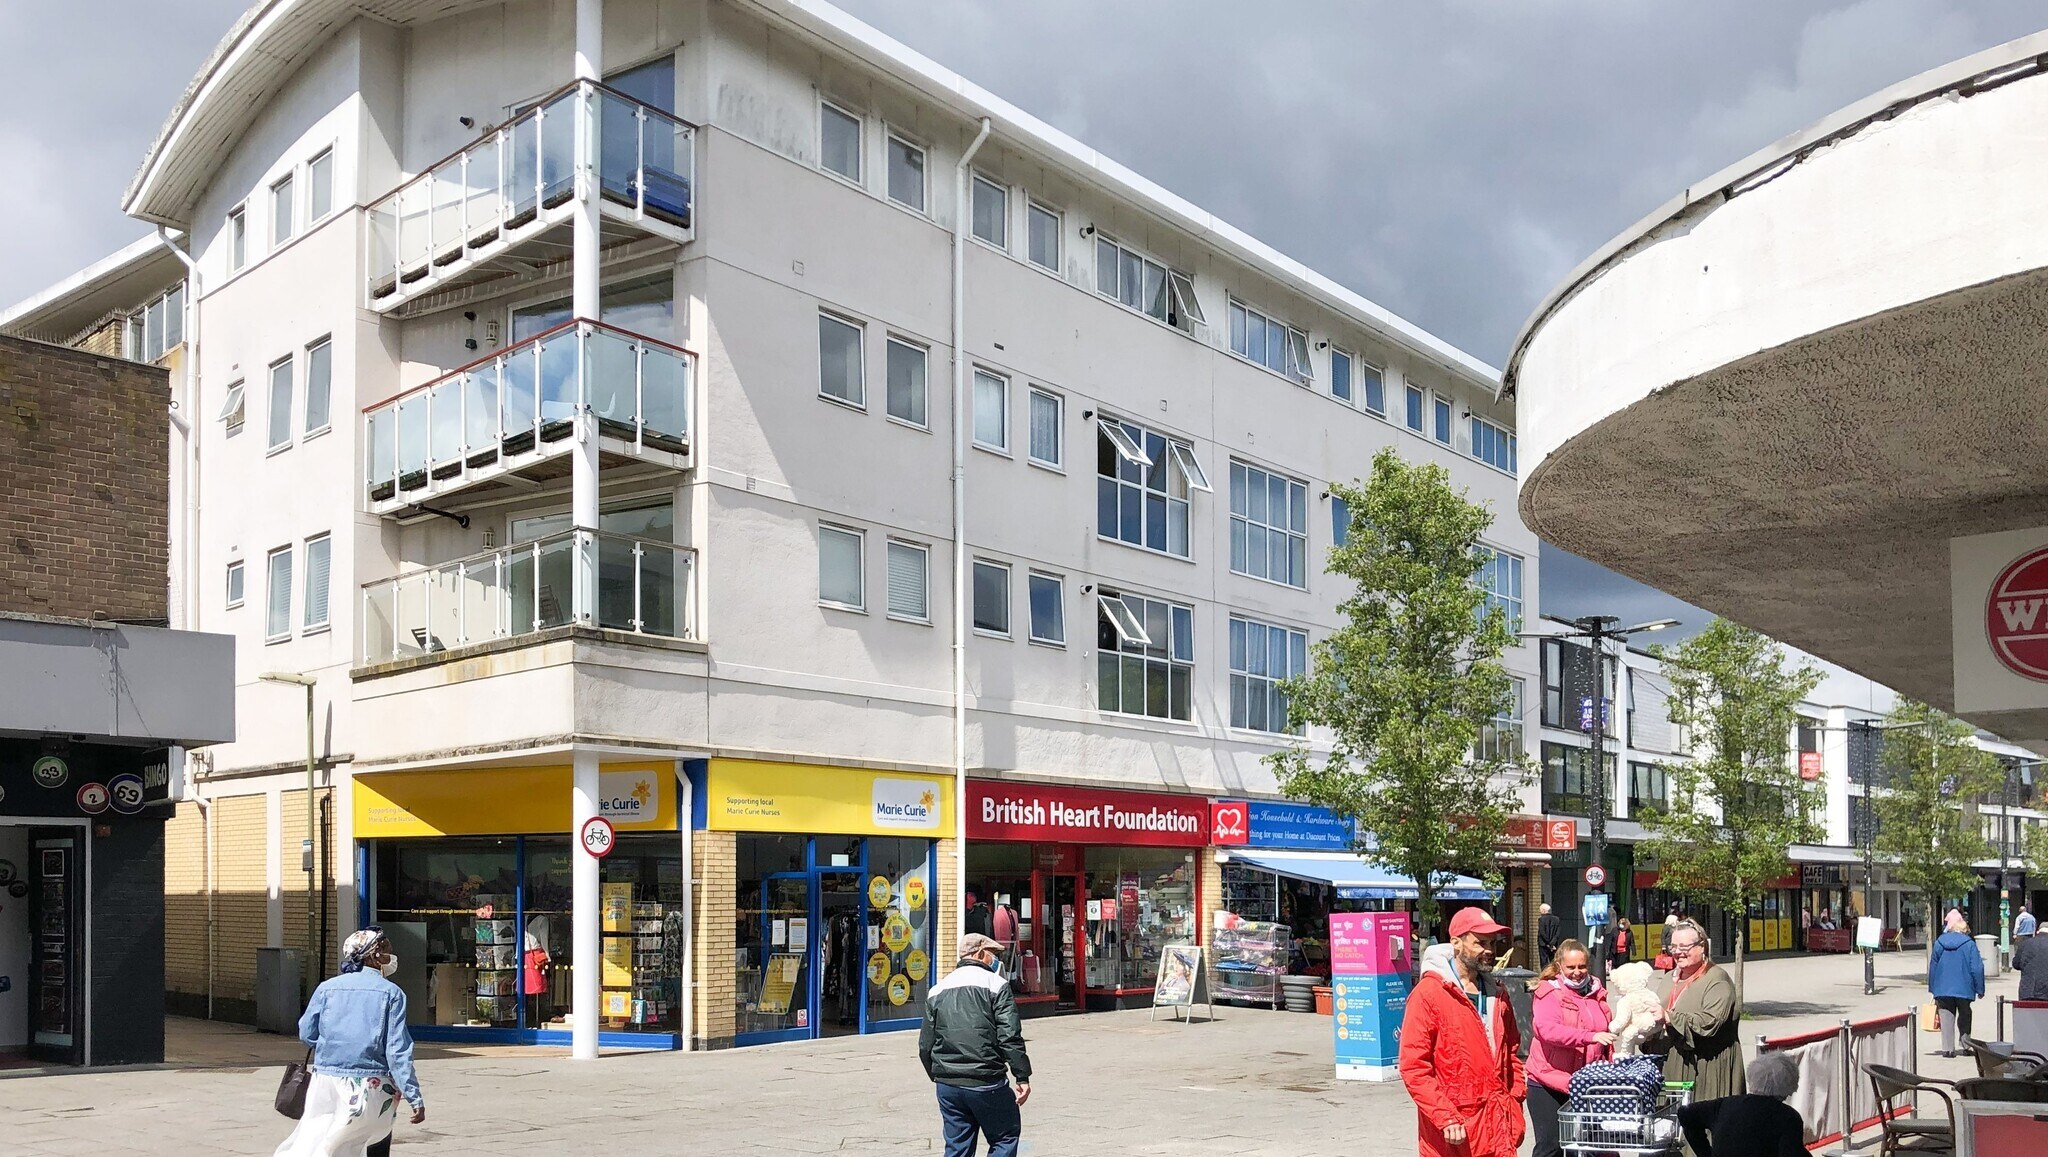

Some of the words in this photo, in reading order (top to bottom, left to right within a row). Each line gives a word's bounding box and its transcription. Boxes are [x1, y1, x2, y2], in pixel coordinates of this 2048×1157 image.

[1997, 599, 2048, 633] W
[41, 766, 60, 780] 33
[144, 762, 167, 790] BINGO
[88, 793, 98, 804] 2
[116, 785, 140, 803] 69
[612, 797, 640, 810] Curie
[726, 796, 759, 807] Supporting
[760, 798, 774, 806] local
[368, 807, 397, 815] Supporting
[726, 807, 744, 815] Marie
[744, 808, 760, 816] Curie
[760, 808, 780, 816] Nurses
[877, 802, 903, 815] Marie
[904, 804, 927, 817] Curie
[982, 797, 1046, 825] British
[1050, 801, 1101, 829] Heart
[1103, 804, 1198, 833] Foundation
[1260, 809, 1294, 823] Household
[1295, 816, 1302, 824] &
[1303, 812, 1336, 826] Hardware
[1263, 830, 1272, 839] for
[1272, 832, 1284, 840] your
[1284, 830, 1299, 840] Home
[1306, 832, 1327, 841] Discount
[1327, 833, 1341, 842] Prices
[1804, 866, 1822, 877] CAFE
